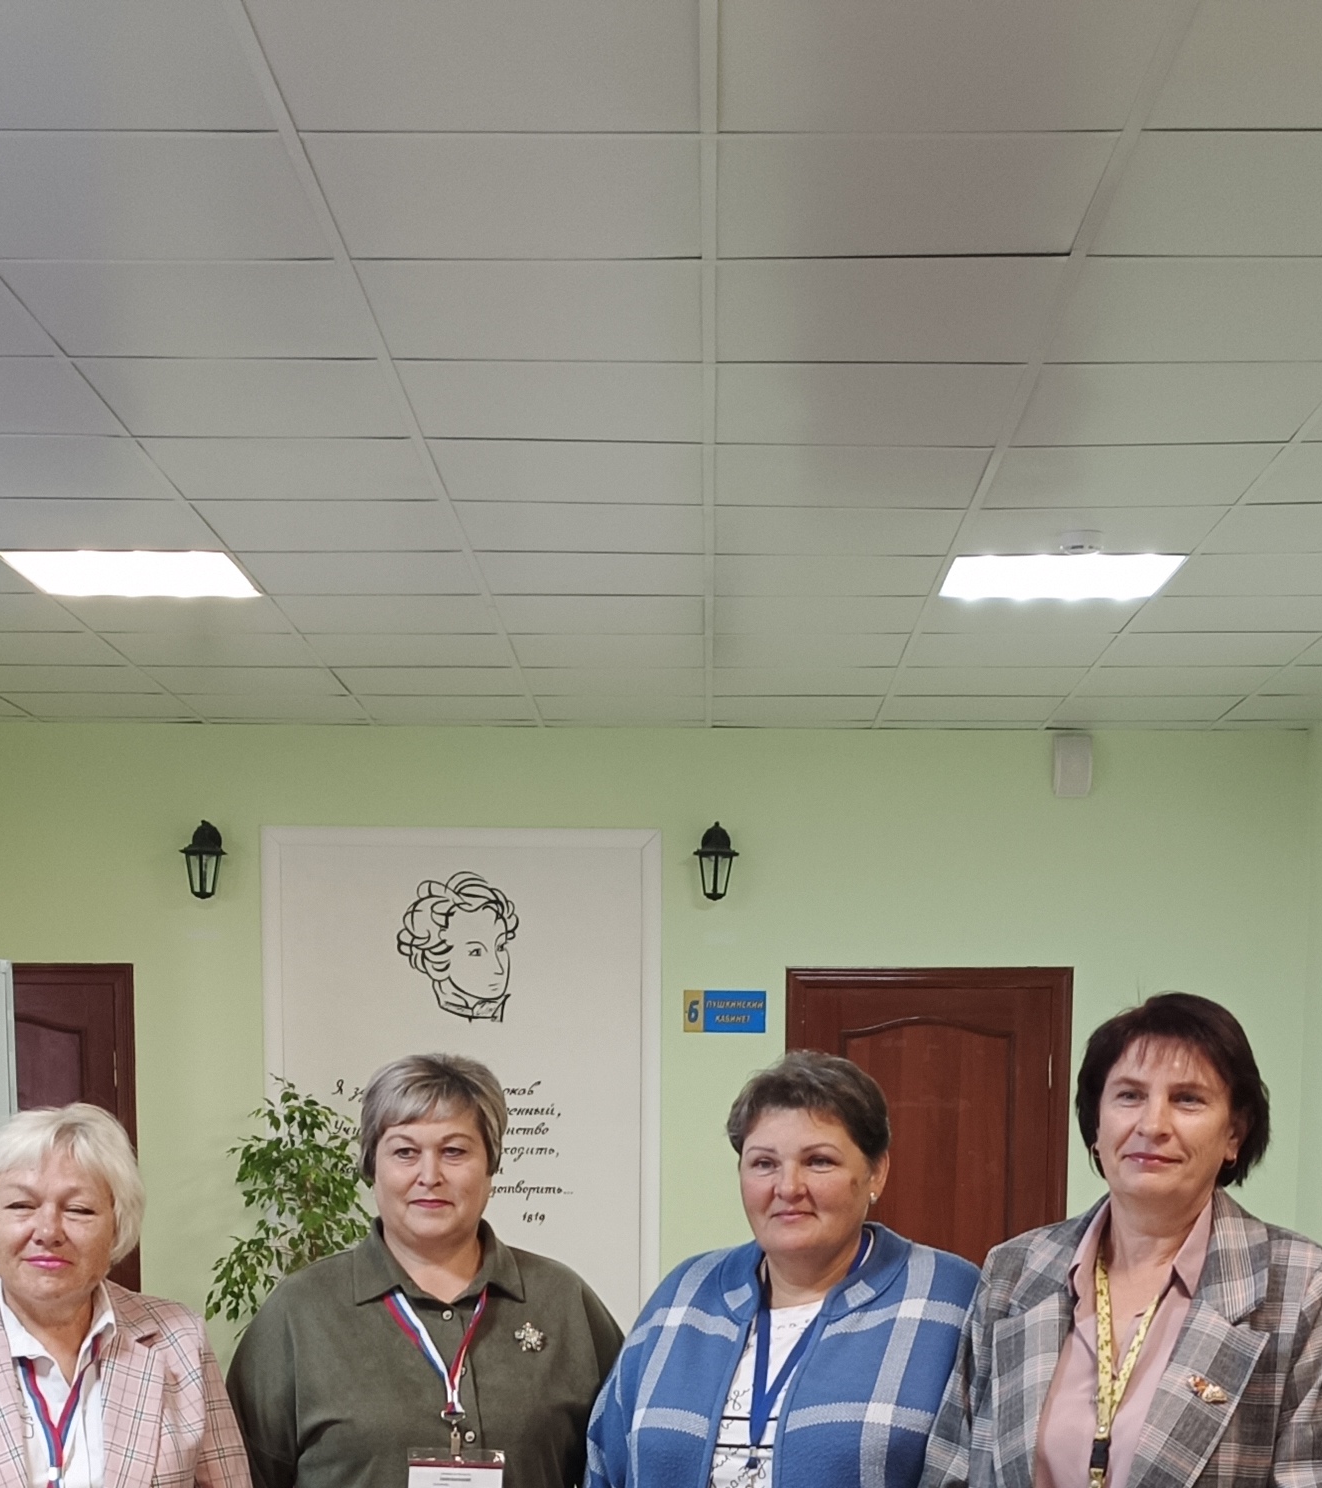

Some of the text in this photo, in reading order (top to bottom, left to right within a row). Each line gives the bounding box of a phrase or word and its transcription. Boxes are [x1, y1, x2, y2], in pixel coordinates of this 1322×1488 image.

[688, 1000, 700, 1023] 6
[715, 1014, 751, 1023] КАБИНЕТ
[331, 1079, 344, 1095] Я
[506, 1122, 549, 1135] нство
[501, 1147, 559, 1162] ходить,
[522, 1212, 546, 1226] 1819
